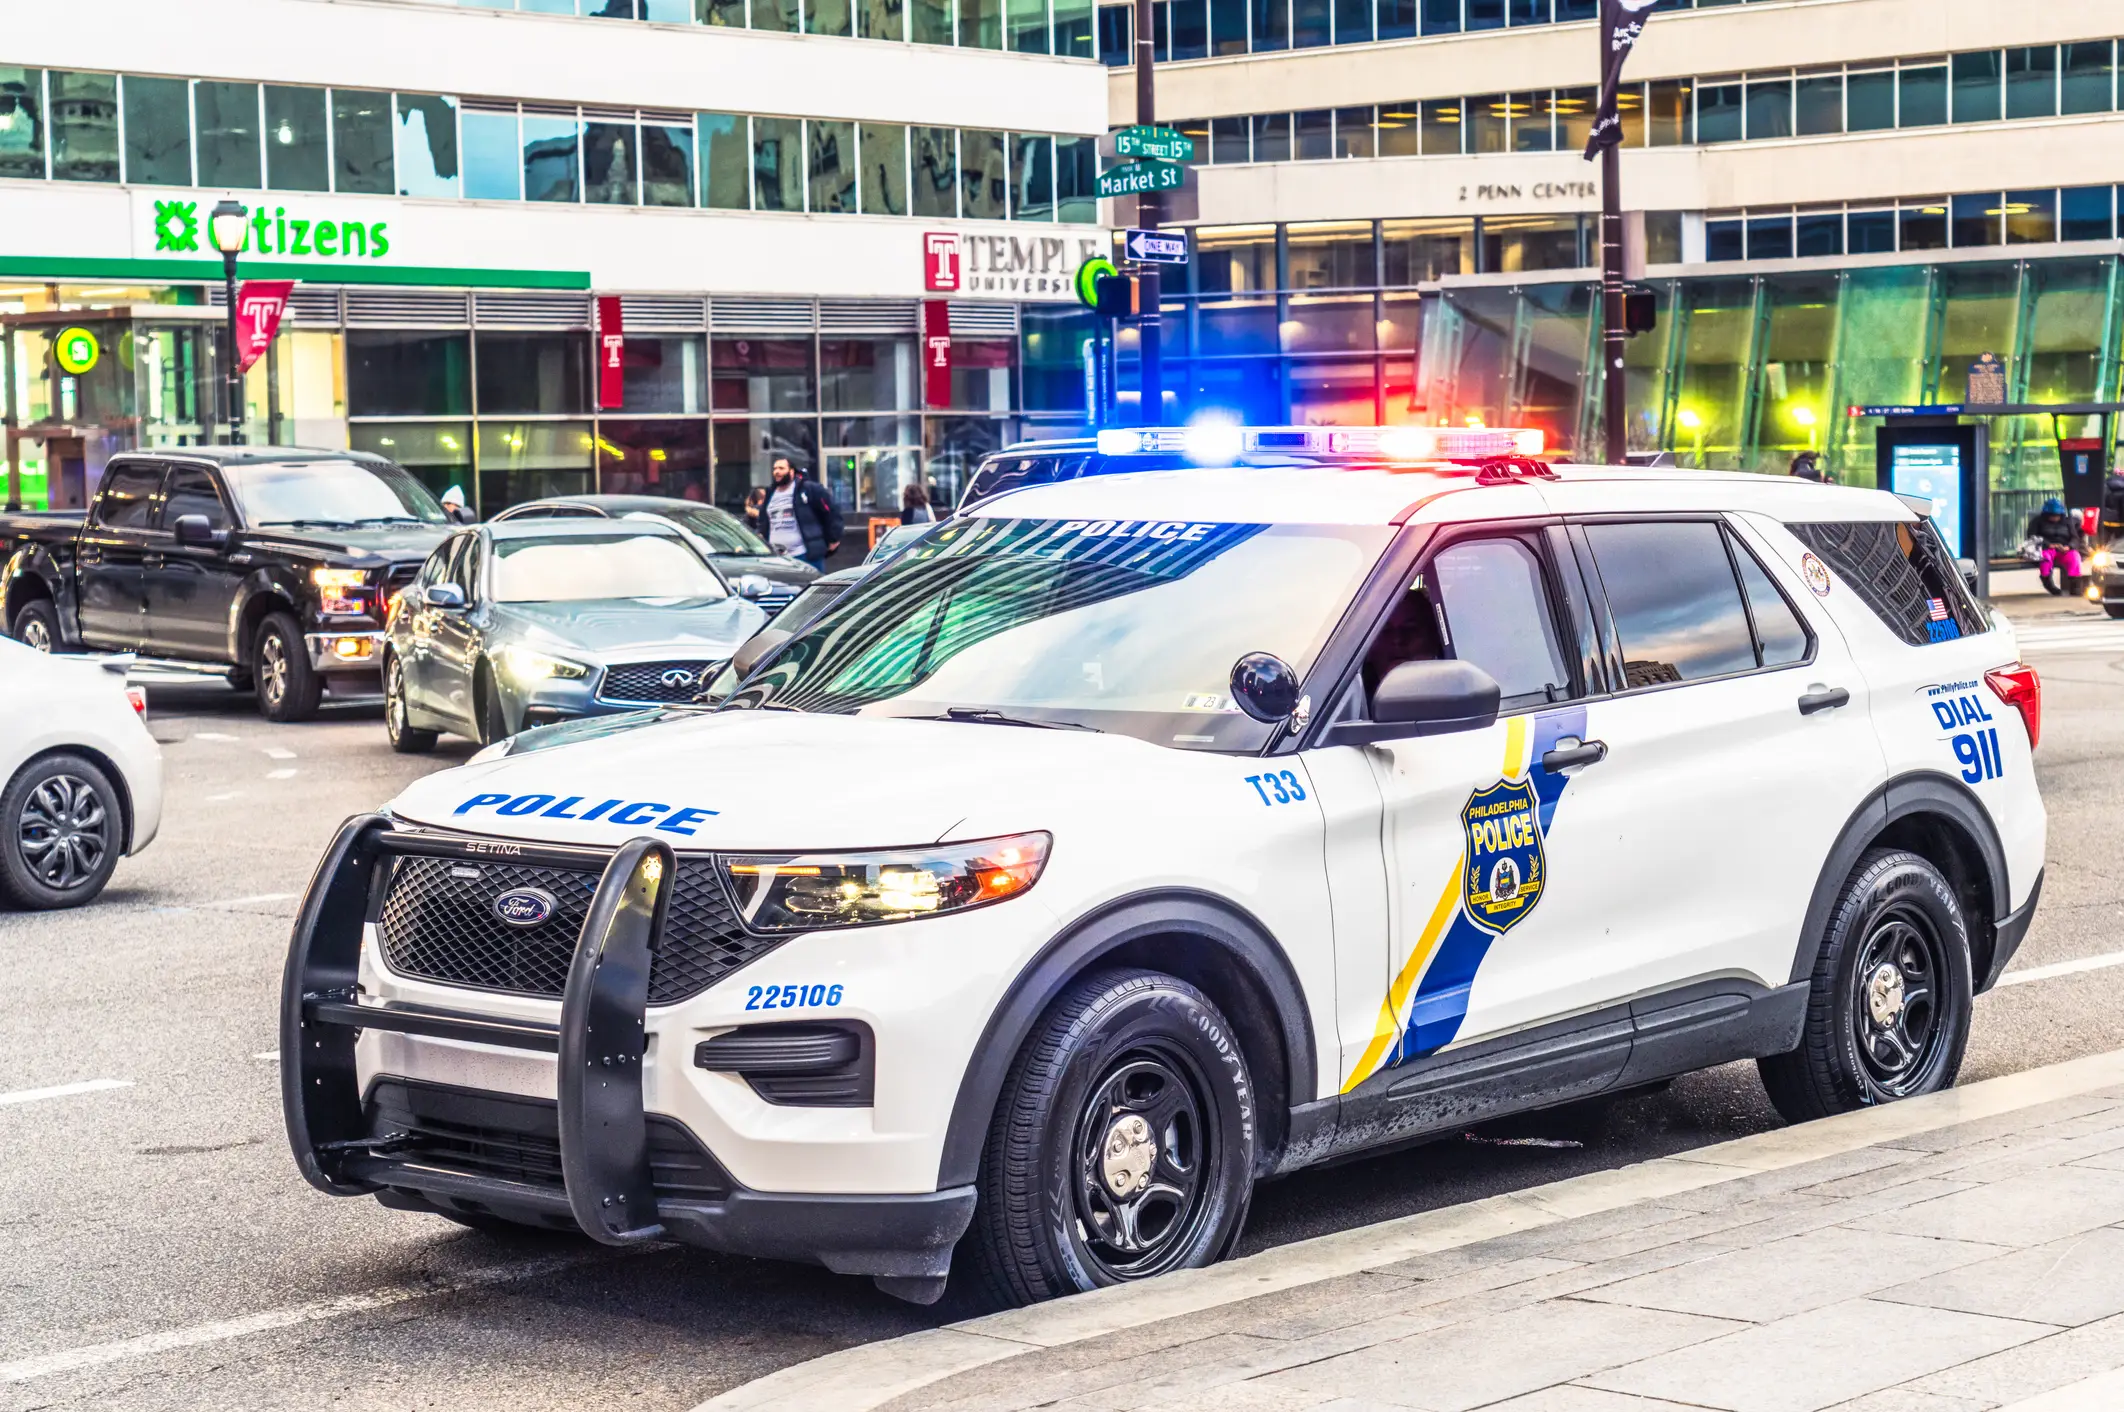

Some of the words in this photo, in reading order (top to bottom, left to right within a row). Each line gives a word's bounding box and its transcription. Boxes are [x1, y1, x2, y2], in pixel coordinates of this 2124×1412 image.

[1142, 143, 1169, 157] STREET
[1101, 171, 1155, 195] Market
[1161, 168, 1177, 187] St
[1459, 186, 1467, 201] 2
[1478, 184, 1522, 199] PENN
[1532, 182, 1596, 199] CENTER
[963, 234, 1097, 275] TEMPLE
[1145, 240, 1162, 253] ONE
[1165, 241, 1181, 254] WAY
[969, 275, 1070, 294] UNIVERSI
[1051, 520, 1216, 541] POLICE
[1926, 617, 1960, 643] 225106
[1931, 695, 1993, 730] DIAL
[1952, 728, 2003, 784] 911
[1244, 770, 1307, 806] T33
[451, 794, 721, 836] POLICE
[1469, 798, 1528, 820] PHILADELPHIA
[1471, 813, 1534, 855] POLICE
[466, 842, 521, 855] SETINA
[1473, 893, 1489, 903] HONOR
[1520, 883, 1539, 893] SERVICE
[504, 897, 536, 917] Ford
[1494, 900, 1517, 911] INTEGRITY
[745, 984, 844, 1011] 225106
